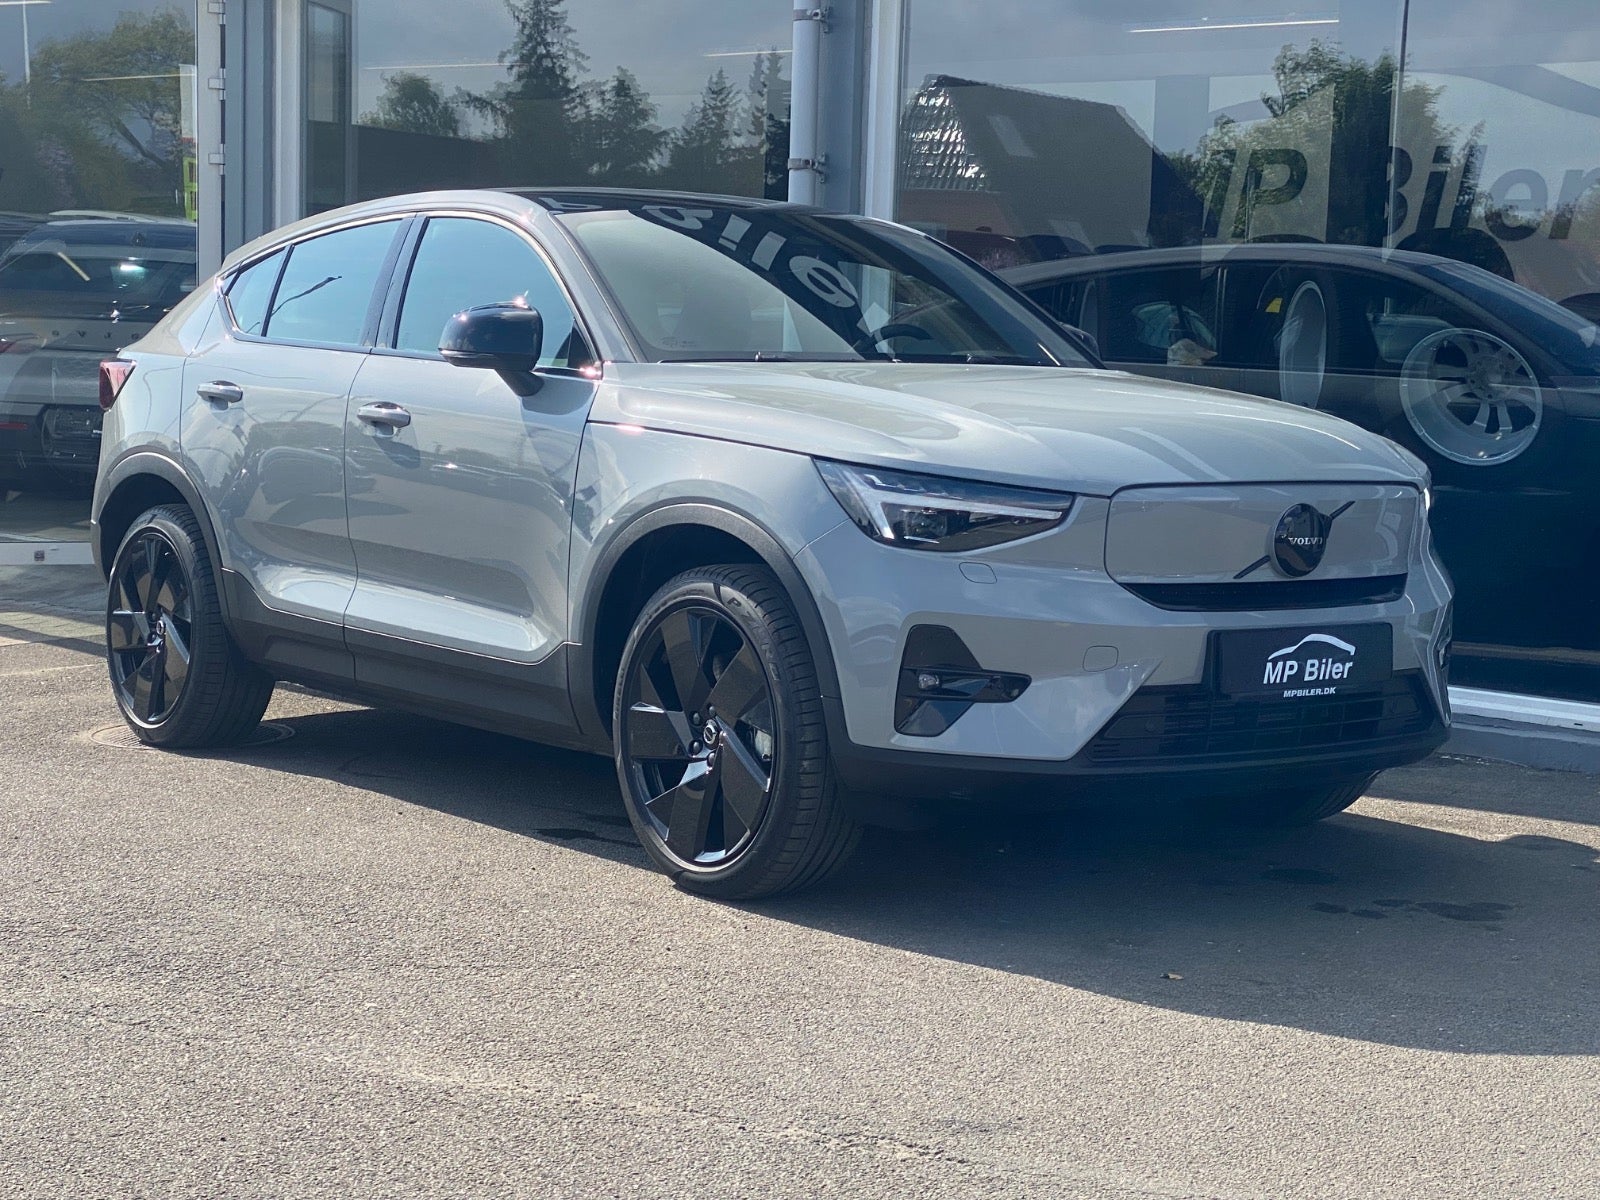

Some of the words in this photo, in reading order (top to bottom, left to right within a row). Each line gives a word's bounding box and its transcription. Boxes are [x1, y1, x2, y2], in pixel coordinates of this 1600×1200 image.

[1263, 661, 1299, 685] MP
[1304, 658, 1354, 682] Biler
[1283, 687, 1337, 698] MPBILER.DK
